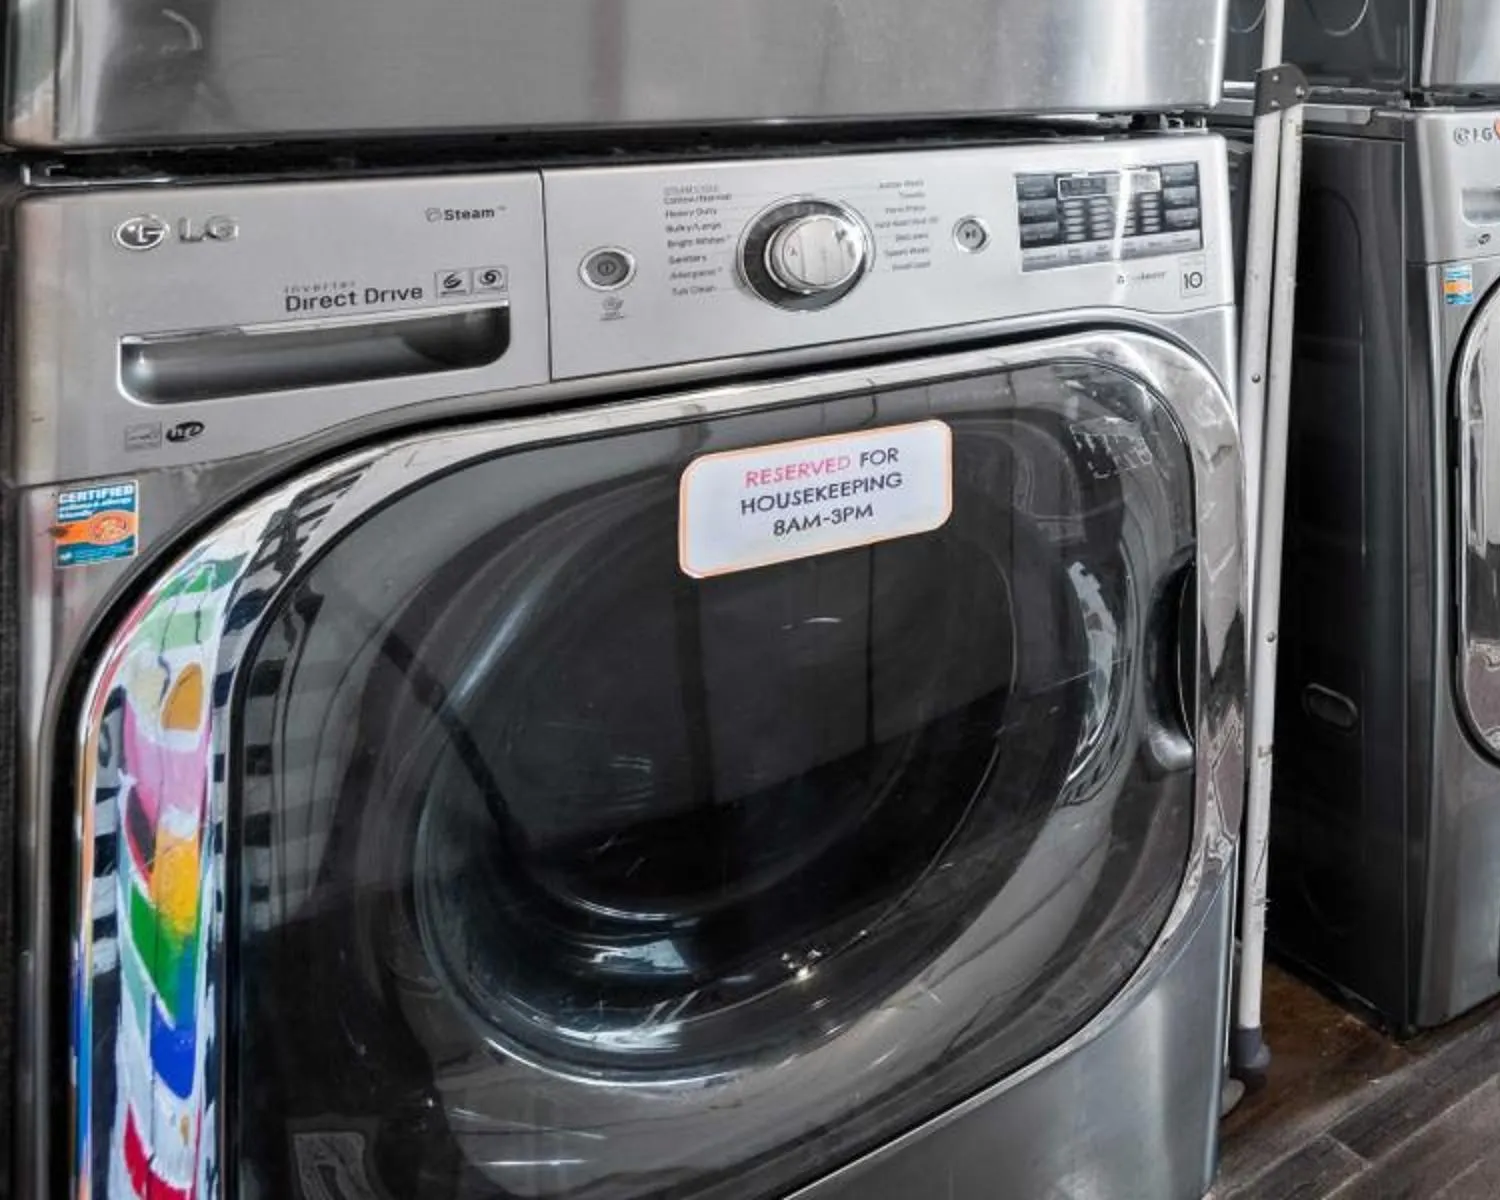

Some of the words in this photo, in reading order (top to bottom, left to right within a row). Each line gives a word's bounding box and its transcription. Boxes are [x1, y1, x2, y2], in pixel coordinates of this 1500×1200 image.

[442, 206, 496, 222] Steam
[177, 215, 240, 243] LG
[1183, 271, 1203, 289] 10
[285, 290, 357, 313] Direct
[363, 286, 424, 306] Drive
[745, 455, 851, 489] RESERVED
[858, 447, 900, 469] FOR
[59, 484, 134, 504] CERTIFIED
[740, 471, 904, 517] HOUSEKEEPING
[772, 503, 875, 538] 8AM-3PM
